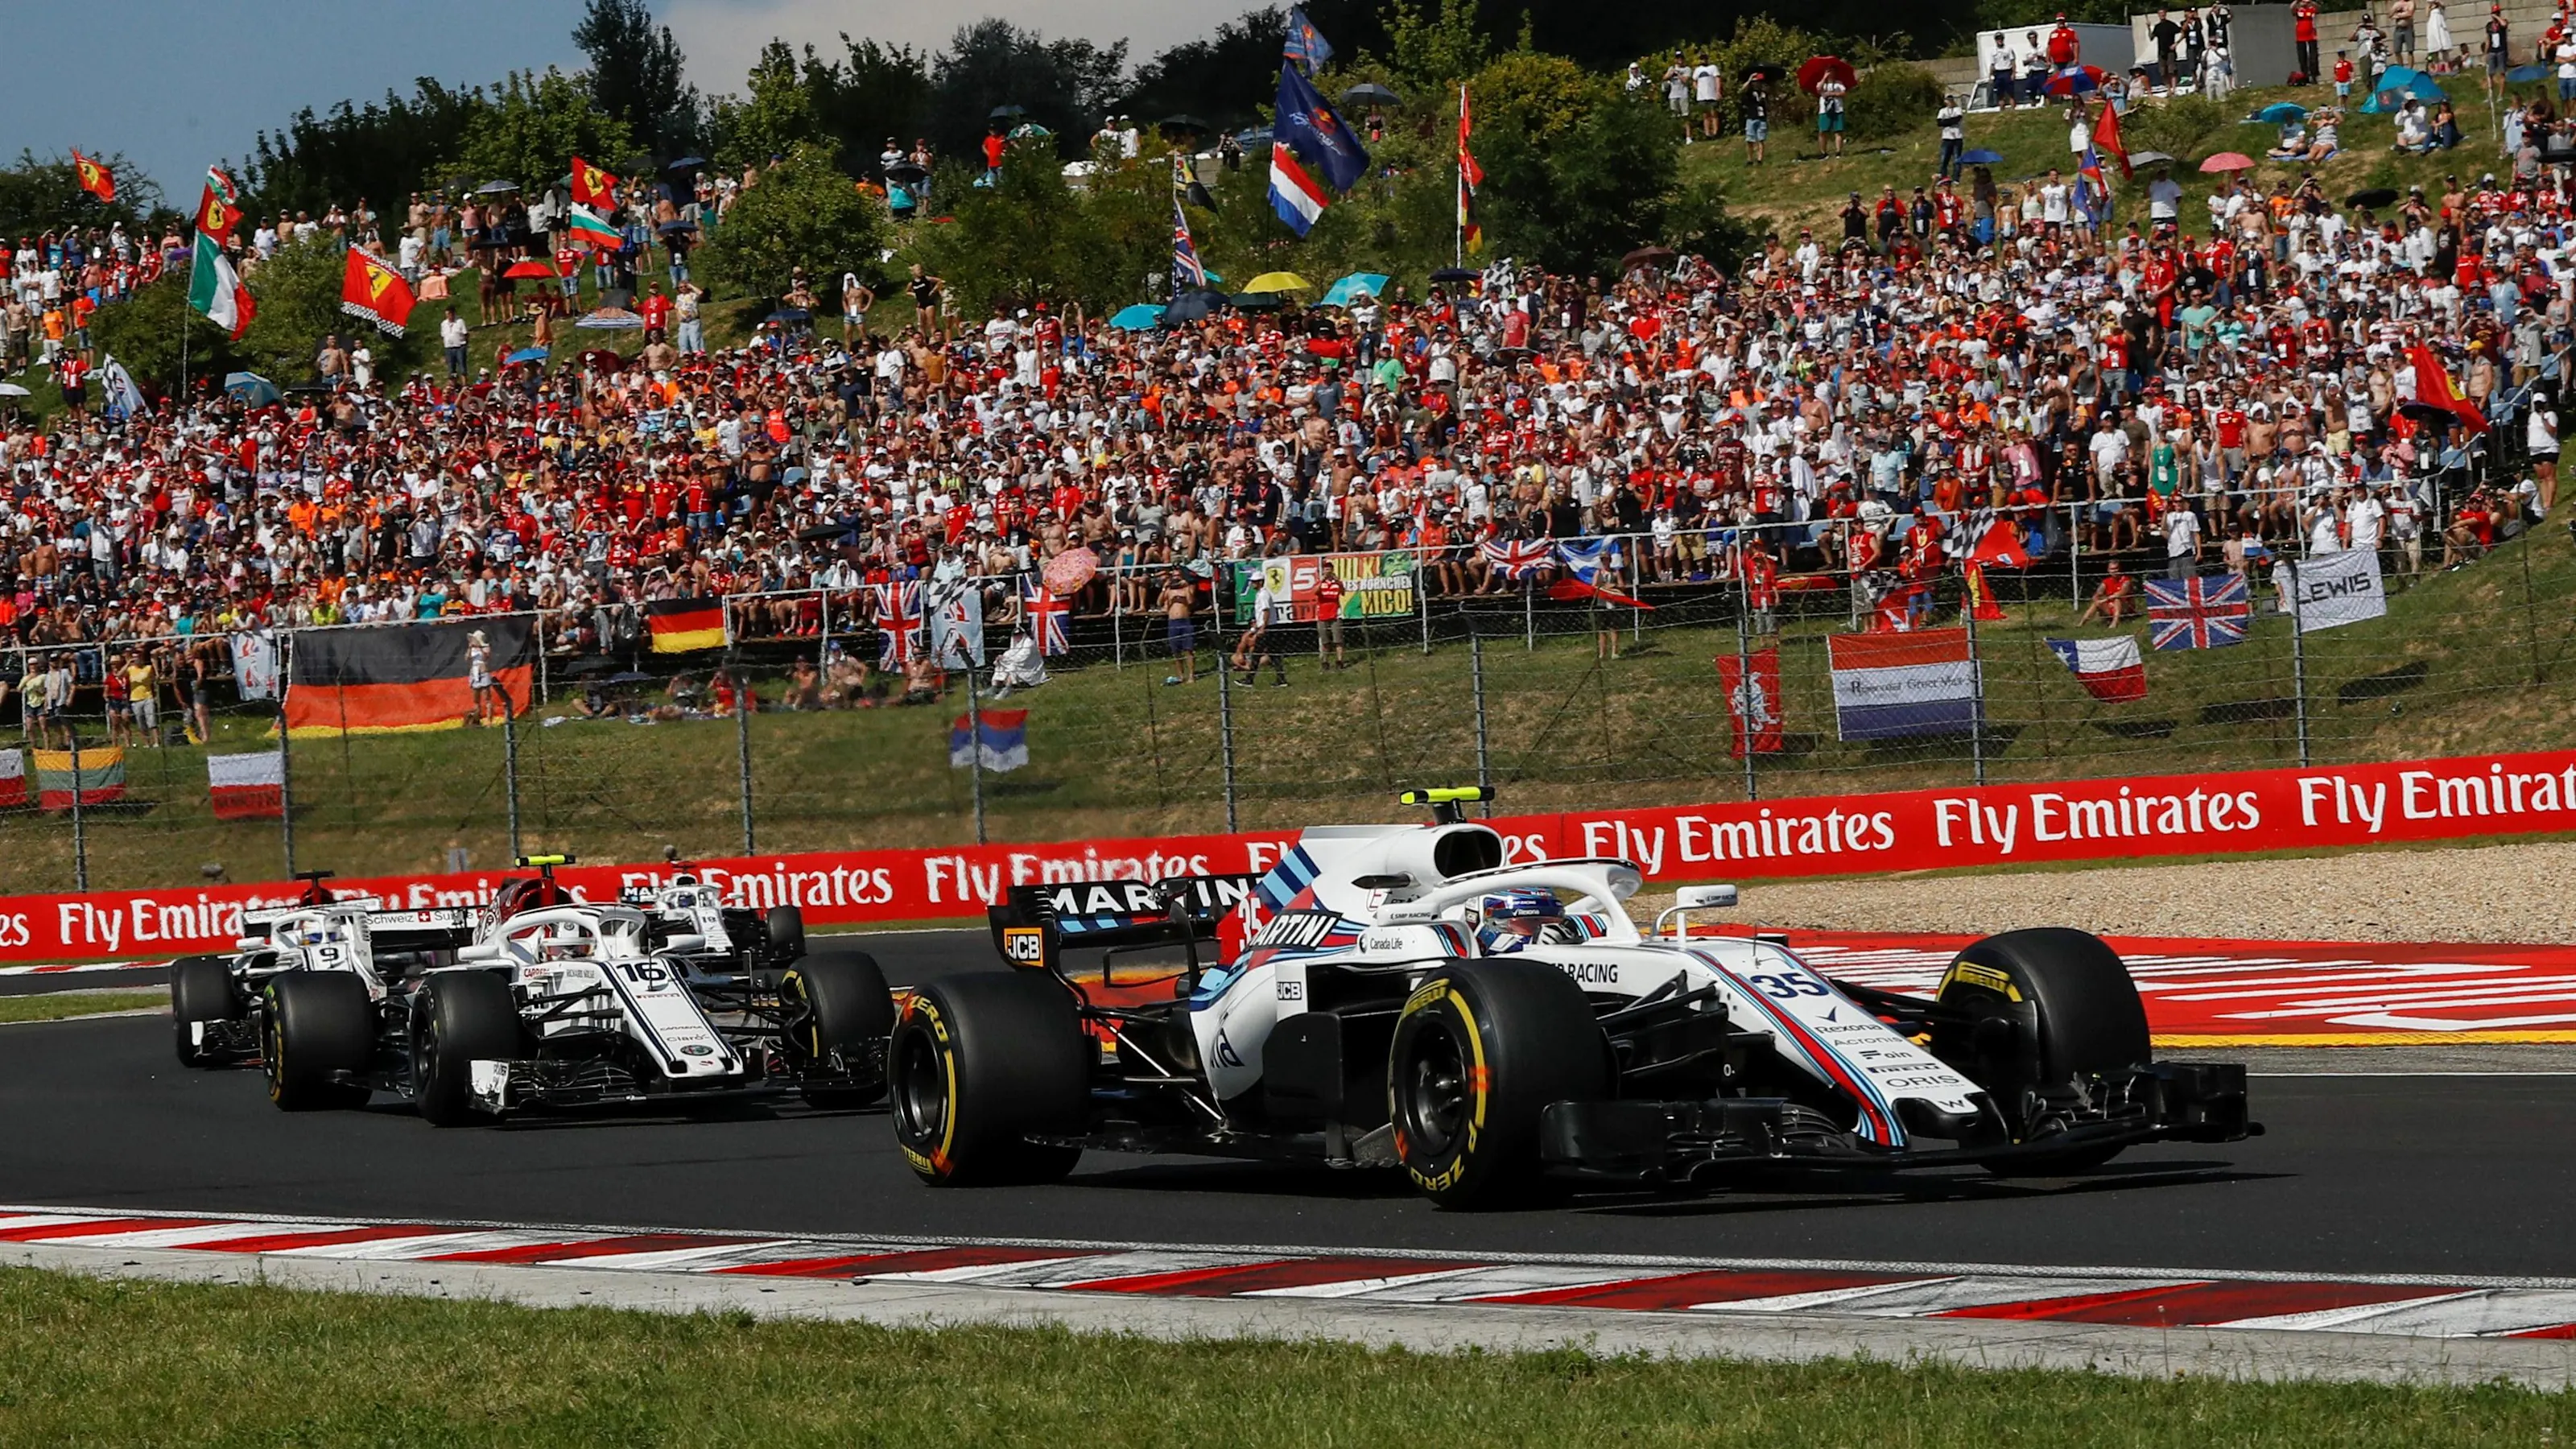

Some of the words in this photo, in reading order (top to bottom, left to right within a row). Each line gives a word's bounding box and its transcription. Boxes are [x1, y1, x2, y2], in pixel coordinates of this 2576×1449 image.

[1292, 567, 1318, 591] 5
[1361, 589, 1413, 615] NICO!
[2297, 776, 2386, 833] Fly
[2399, 763, 2576, 819] Emirat
[1934, 799, 2017, 854] Fly
[2029, 786, 2260, 841] Emirates
[1581, 820, 1665, 875] Fly
[1676, 808, 1894, 861] Emirates
[924, 856, 999, 906] Fly
[57, 902, 122, 952] Fly
[319, 947, 339, 962] 9
[1006, 935, 1040, 960] JCB
[1370, 938, 1390, 949] Canada
[1391, 937, 1402, 949] Life
[617, 962, 667, 982] 16
[1568, 964, 1619, 983] RACING
[1278, 983, 1301, 999] JCB
[1749, 972, 1830, 999] 35
[910, 995, 948, 1042] ZERO
[1814, 1024, 1883, 1034] Rexona
[1834, 1036, 1903, 1046] Acronis
[1886, 1075, 1960, 1088] ORIS
[1410, 1154, 1465, 1191] ZERO
